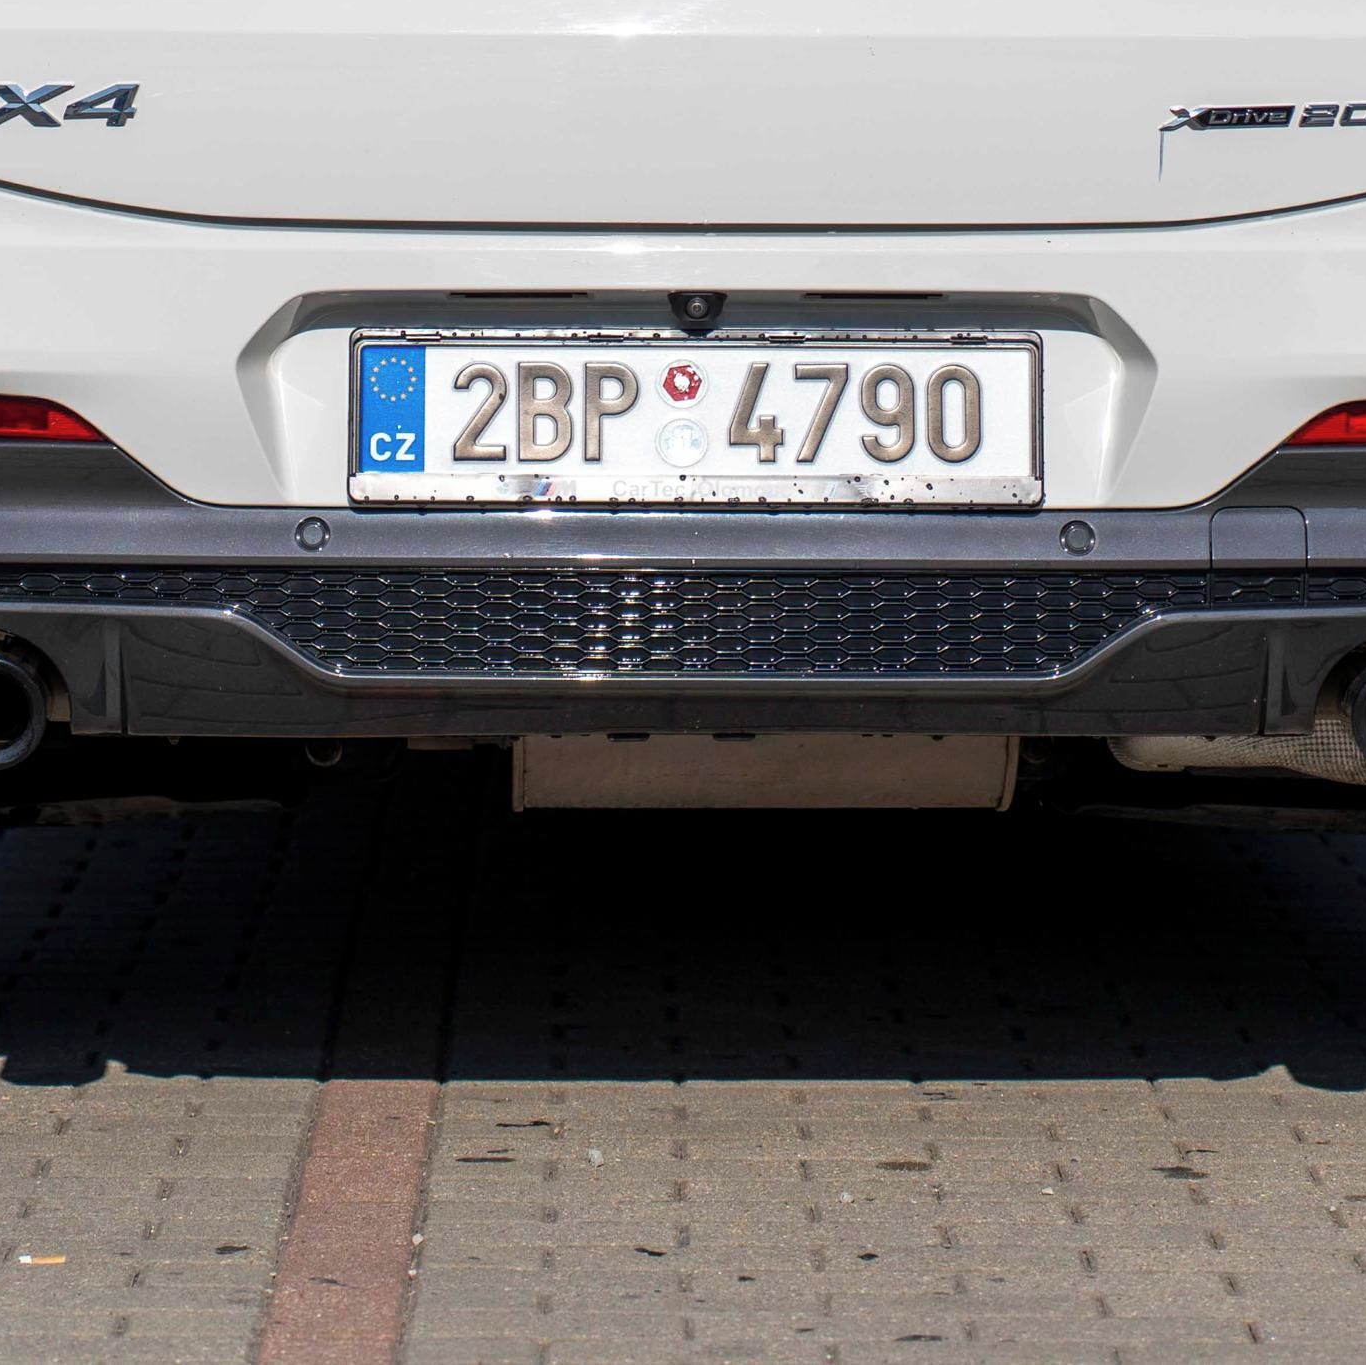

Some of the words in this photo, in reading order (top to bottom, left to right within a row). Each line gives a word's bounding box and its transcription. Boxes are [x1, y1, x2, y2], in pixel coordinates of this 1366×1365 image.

[452, 361, 639, 463] 2BP
[728, 361, 981, 464] 4790
[369, 432, 416, 462] CZ
[612, 479, 685, 497] CarTec
[699, 480, 793, 498] Olomo
